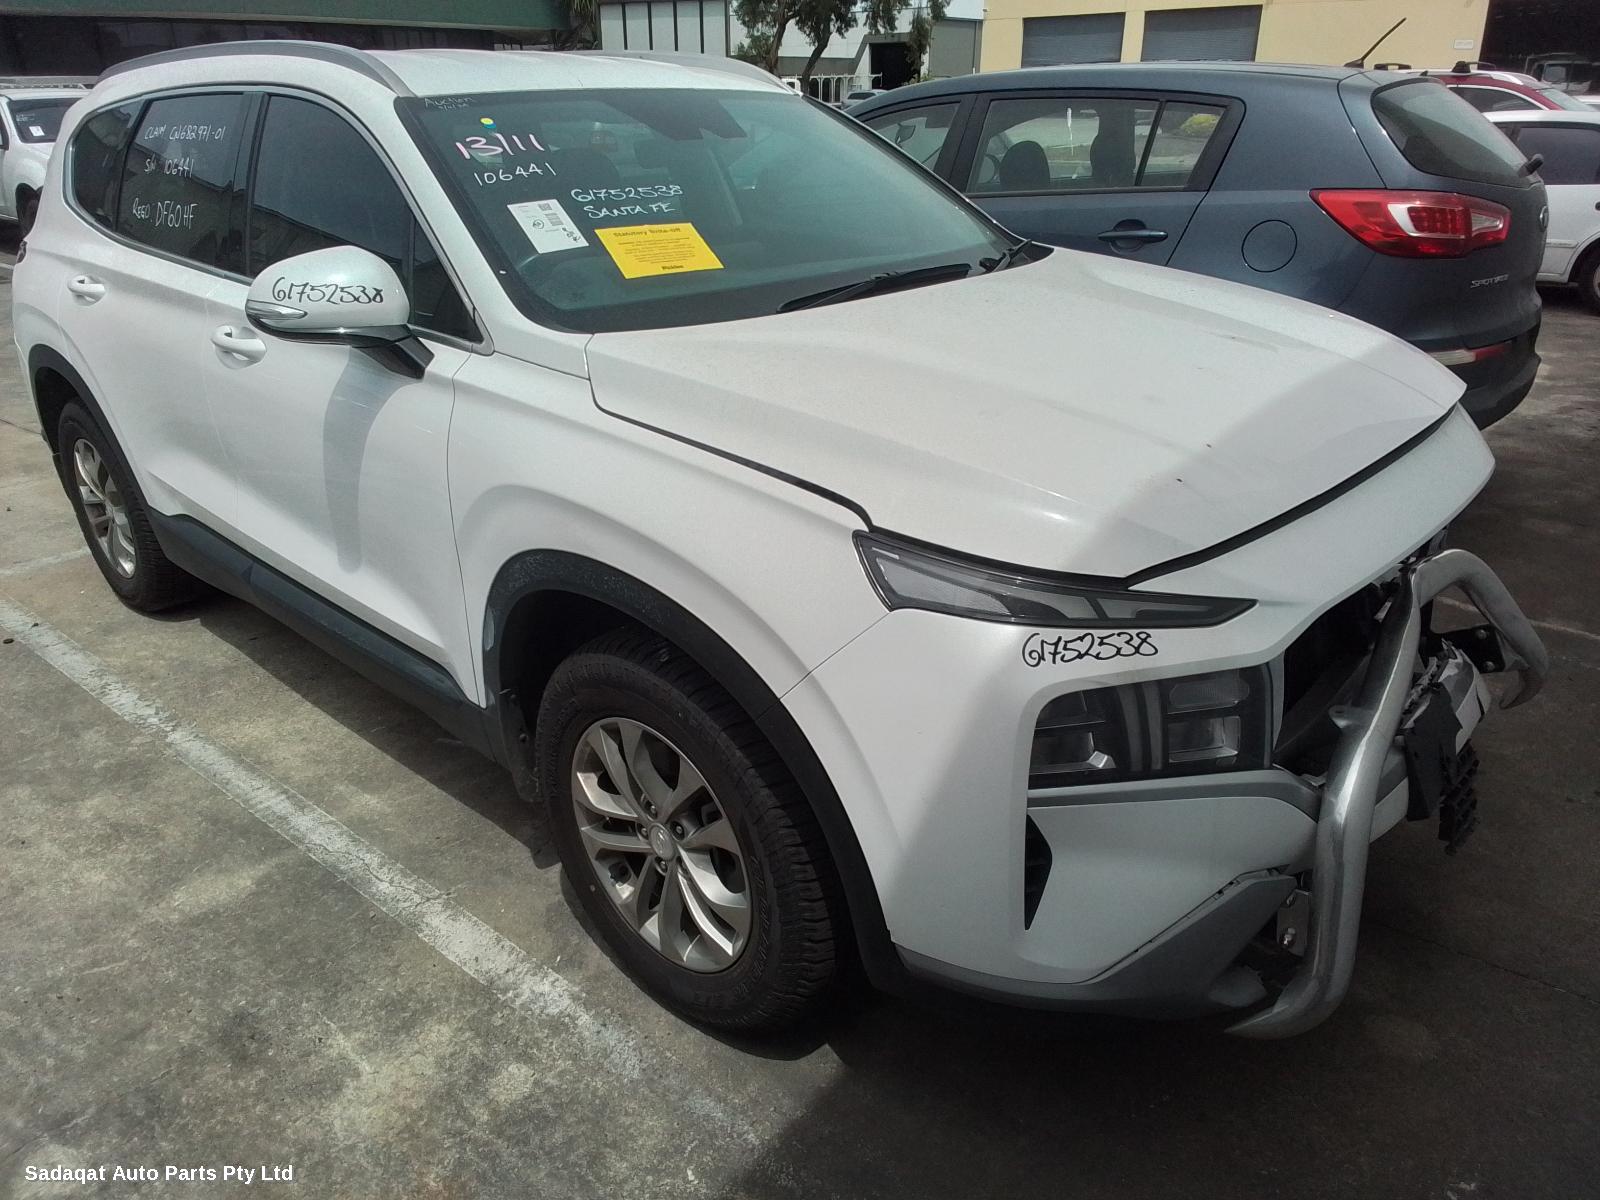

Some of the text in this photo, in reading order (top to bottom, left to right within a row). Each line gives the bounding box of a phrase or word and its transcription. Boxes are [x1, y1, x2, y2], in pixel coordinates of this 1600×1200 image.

[455, 132, 545, 160] 13/11
[164, 157, 195, 179] 106441
[473, 162, 557, 187] 106441
[570, 184, 684, 202] 61752538
[583, 202, 676, 219] SANTA FE
[272, 277, 383, 304] 61752538
[1022, 631, 1159, 668] 61752538
